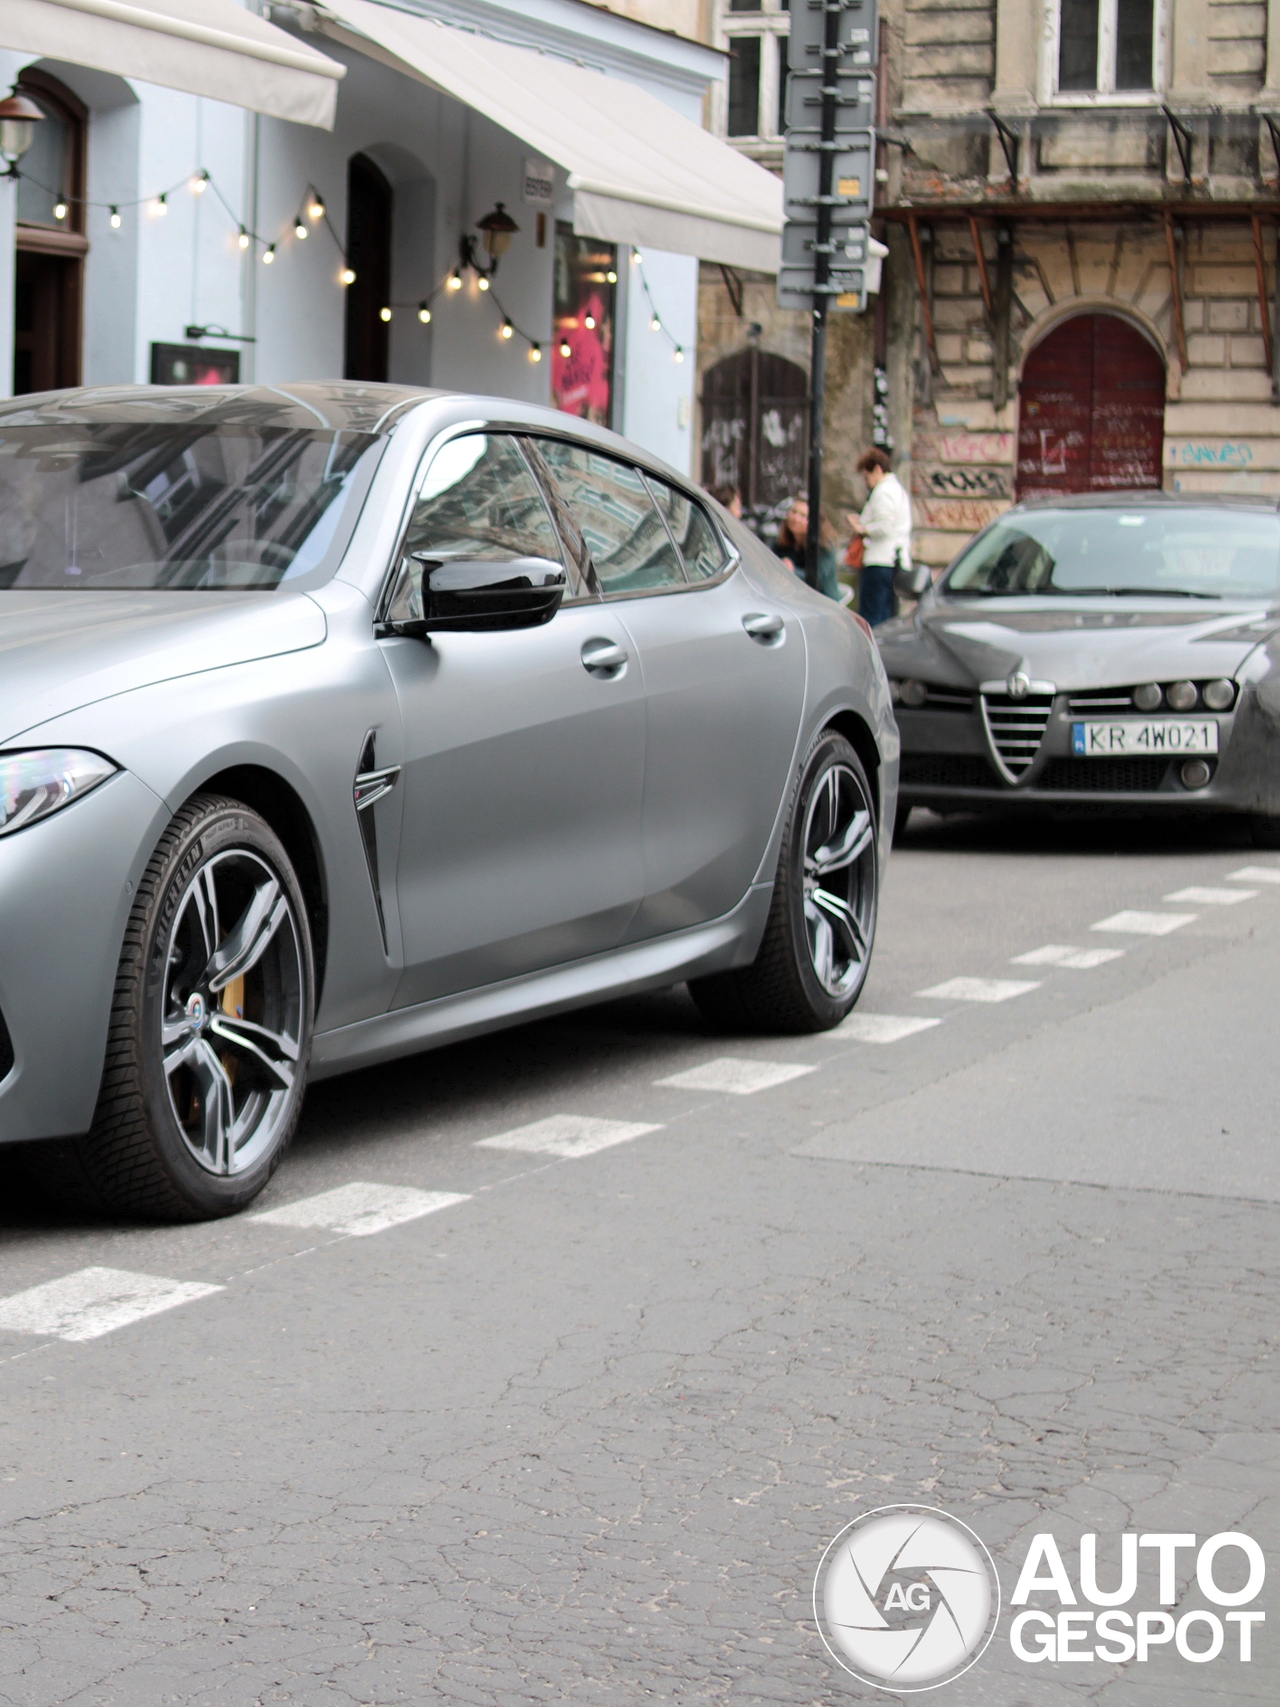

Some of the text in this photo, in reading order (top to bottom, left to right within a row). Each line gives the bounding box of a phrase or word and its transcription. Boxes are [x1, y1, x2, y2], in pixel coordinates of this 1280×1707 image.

[1090, 725, 1208, 749] KR 4W021
[156, 843, 202, 947] MICHELIN
